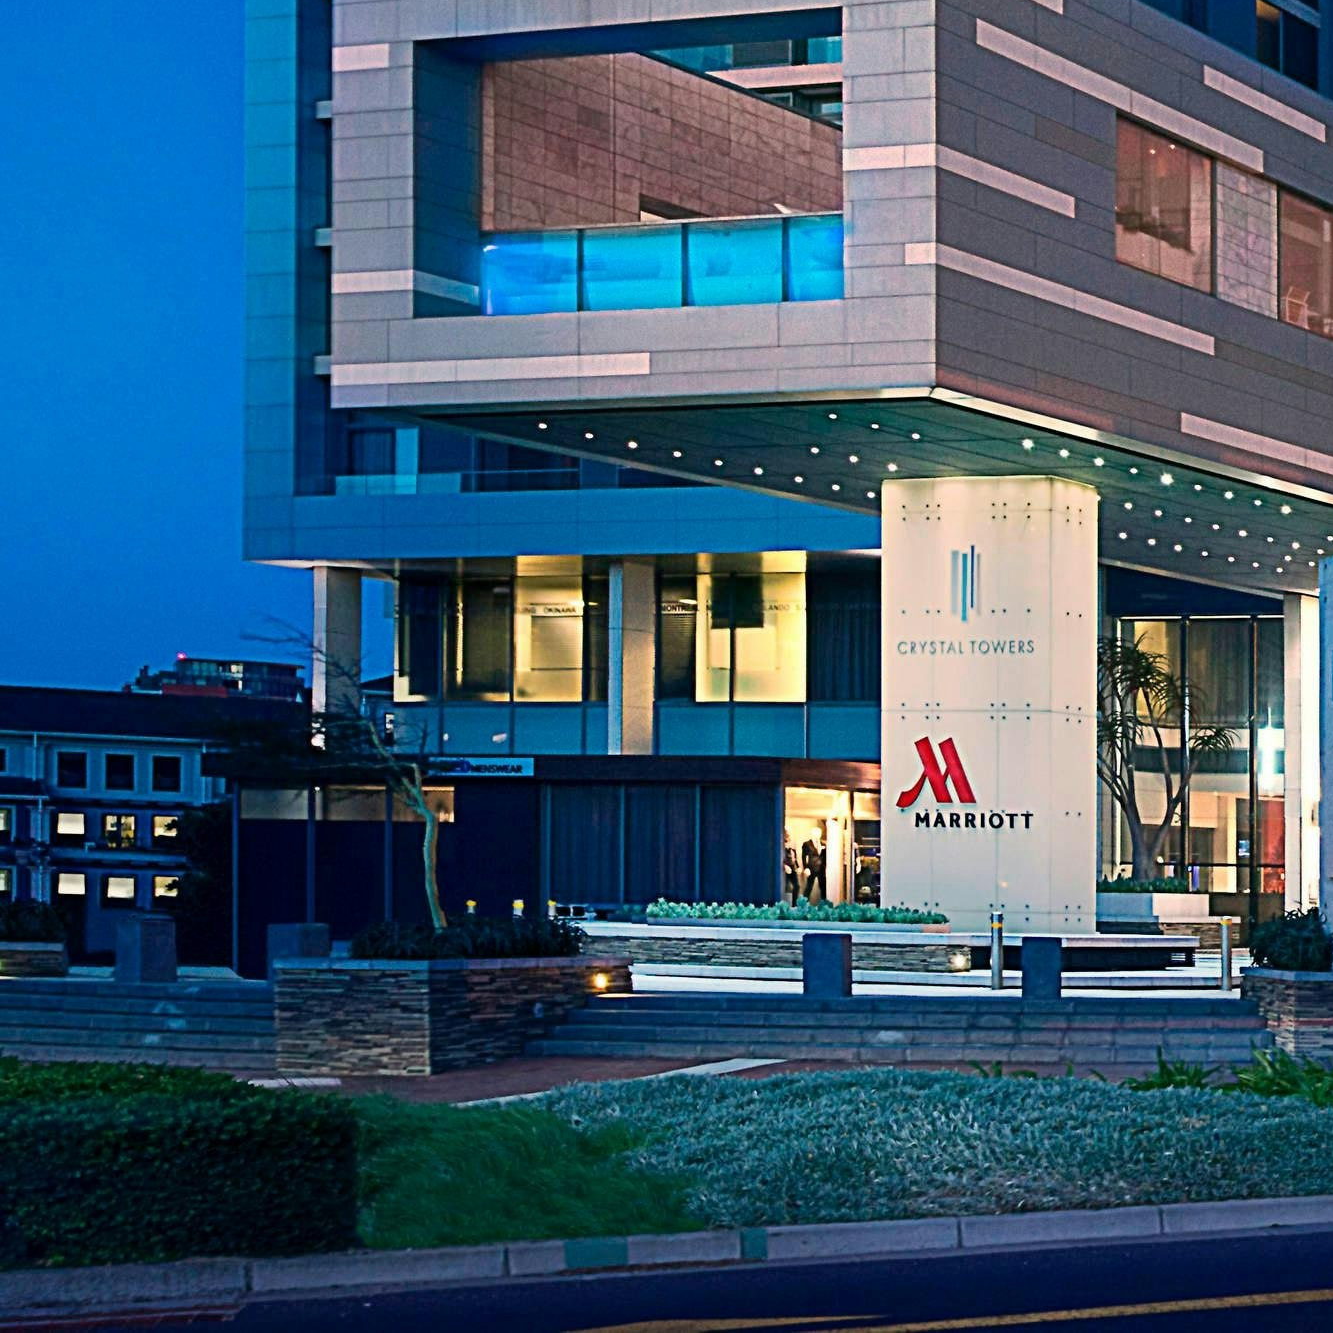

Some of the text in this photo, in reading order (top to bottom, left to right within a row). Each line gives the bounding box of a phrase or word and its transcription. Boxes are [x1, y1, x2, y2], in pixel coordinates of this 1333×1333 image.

[897, 640, 1035, 655] CRYSTAL TOWERS
[915, 813, 1034, 829] MARRIOTT
